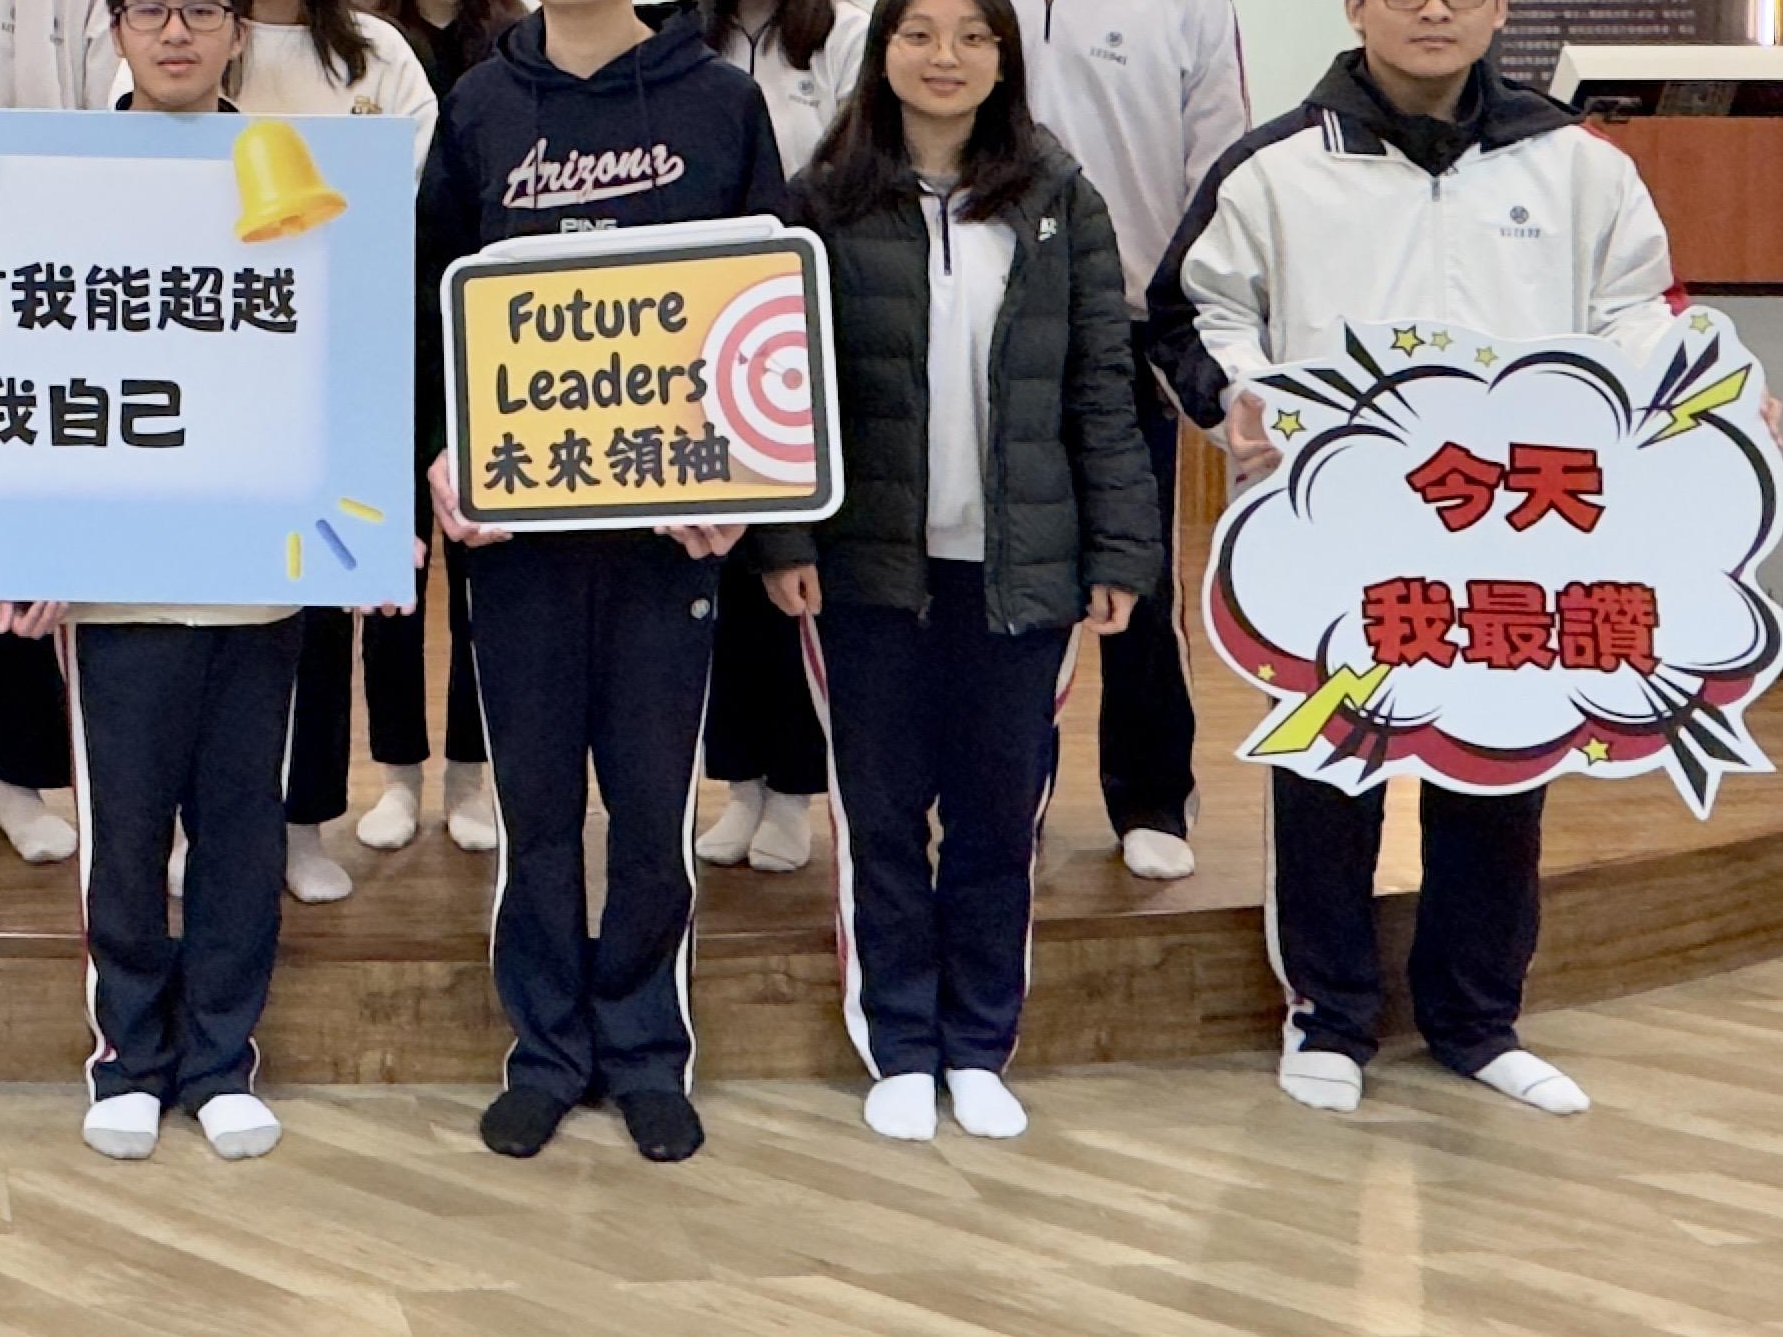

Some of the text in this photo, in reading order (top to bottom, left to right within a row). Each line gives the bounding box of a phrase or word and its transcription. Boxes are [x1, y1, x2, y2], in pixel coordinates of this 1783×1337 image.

[508, 289, 688, 343] Future
[496, 352, 708, 415] Leaders
[483, 421, 731, 494] 未來領袖
[1405, 441, 1606, 533] 今天
[1361, 575, 1661, 675] 我最讚
